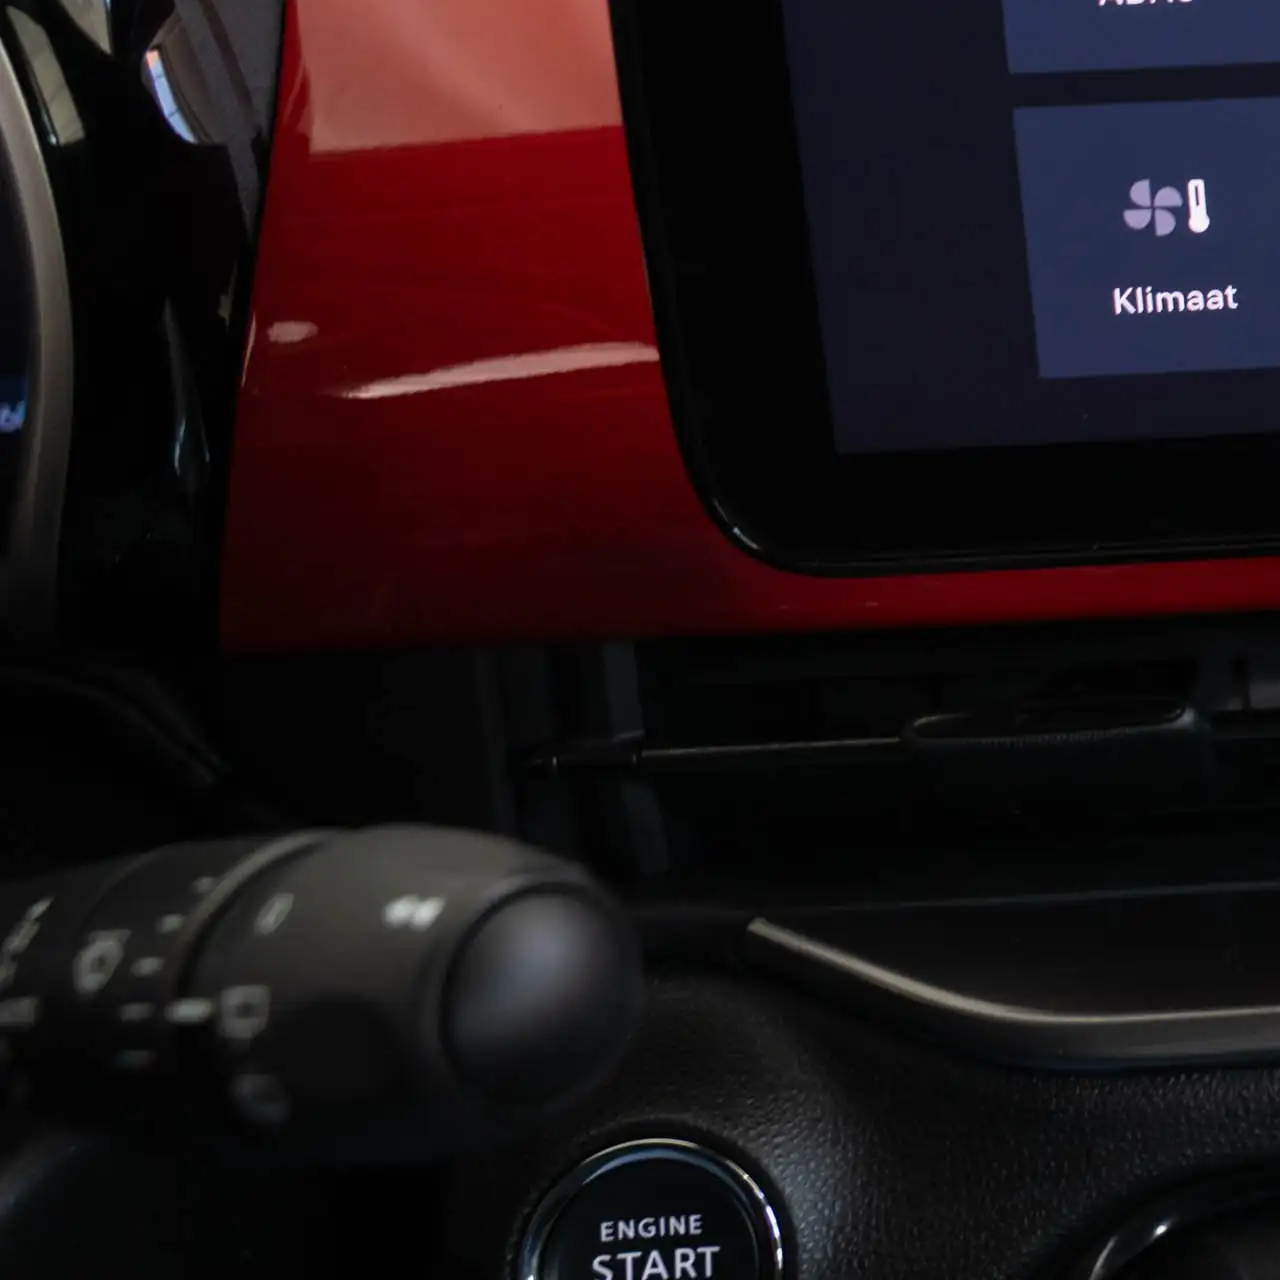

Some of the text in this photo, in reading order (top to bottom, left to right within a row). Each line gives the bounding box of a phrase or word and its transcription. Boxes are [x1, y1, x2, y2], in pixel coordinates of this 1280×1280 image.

[1113, 285, 1239, 315] Klimaat
[600, 1213, 702, 1242] ENGINE
[592, 1245, 721, 1280] START
